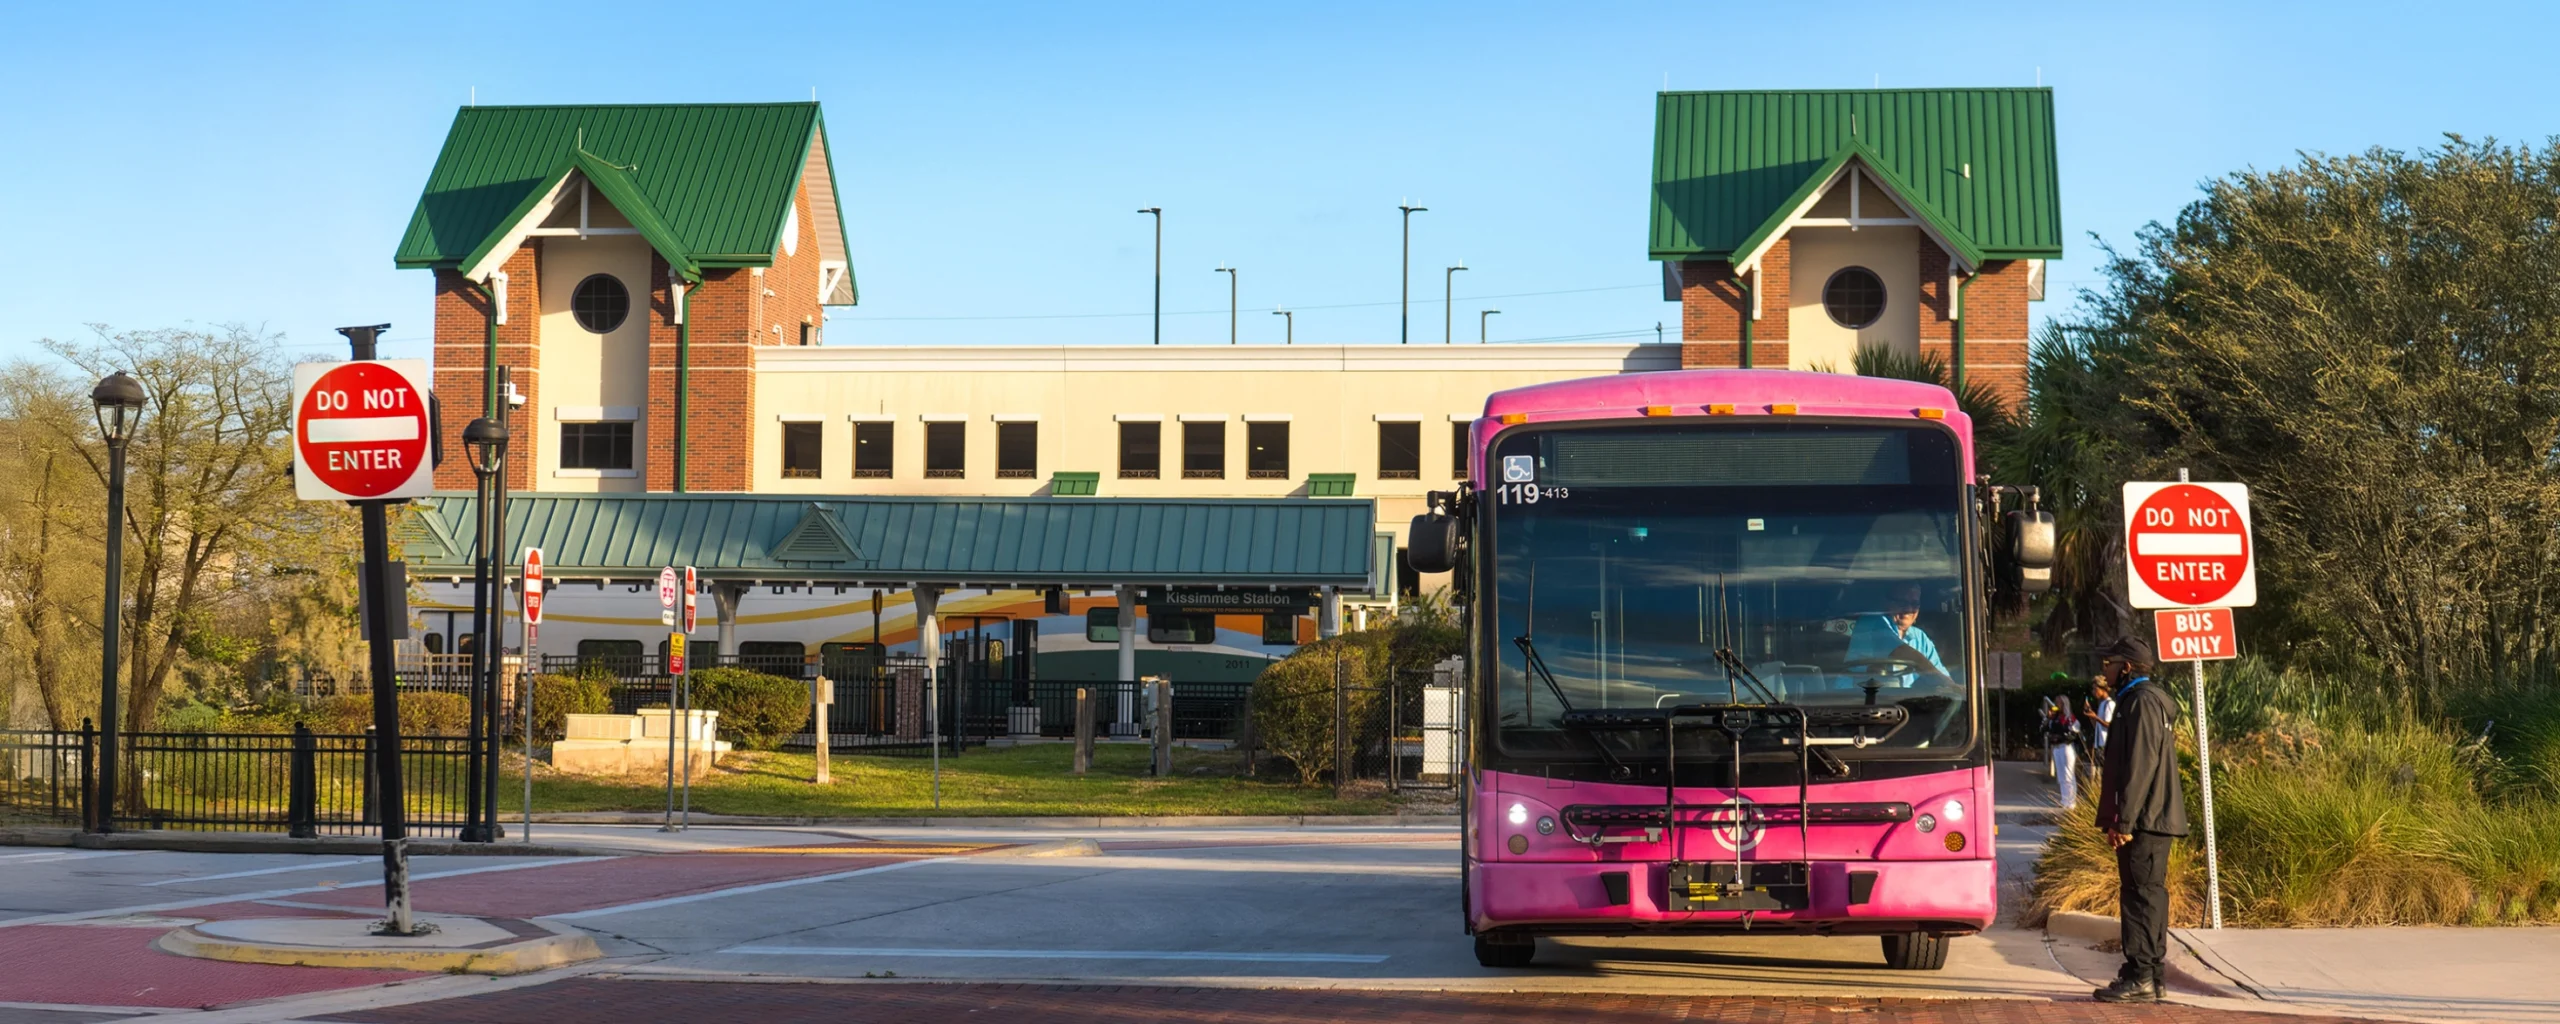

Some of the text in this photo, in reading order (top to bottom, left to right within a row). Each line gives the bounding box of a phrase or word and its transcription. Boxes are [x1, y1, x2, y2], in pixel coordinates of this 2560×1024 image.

[316, 388, 408, 411] DO NOT
[328, 448, 403, 471] ENTER
[2145, 507, 2231, 527] DO NOT
[2156, 561, 2227, 582] ENTER
[1166, 592, 1290, 604] Kissimmee Station
[2175, 612, 2214, 632] BUS
[2171, 635, 2222, 656] ONLY
[1225, 659, 1250, 669] 2011
